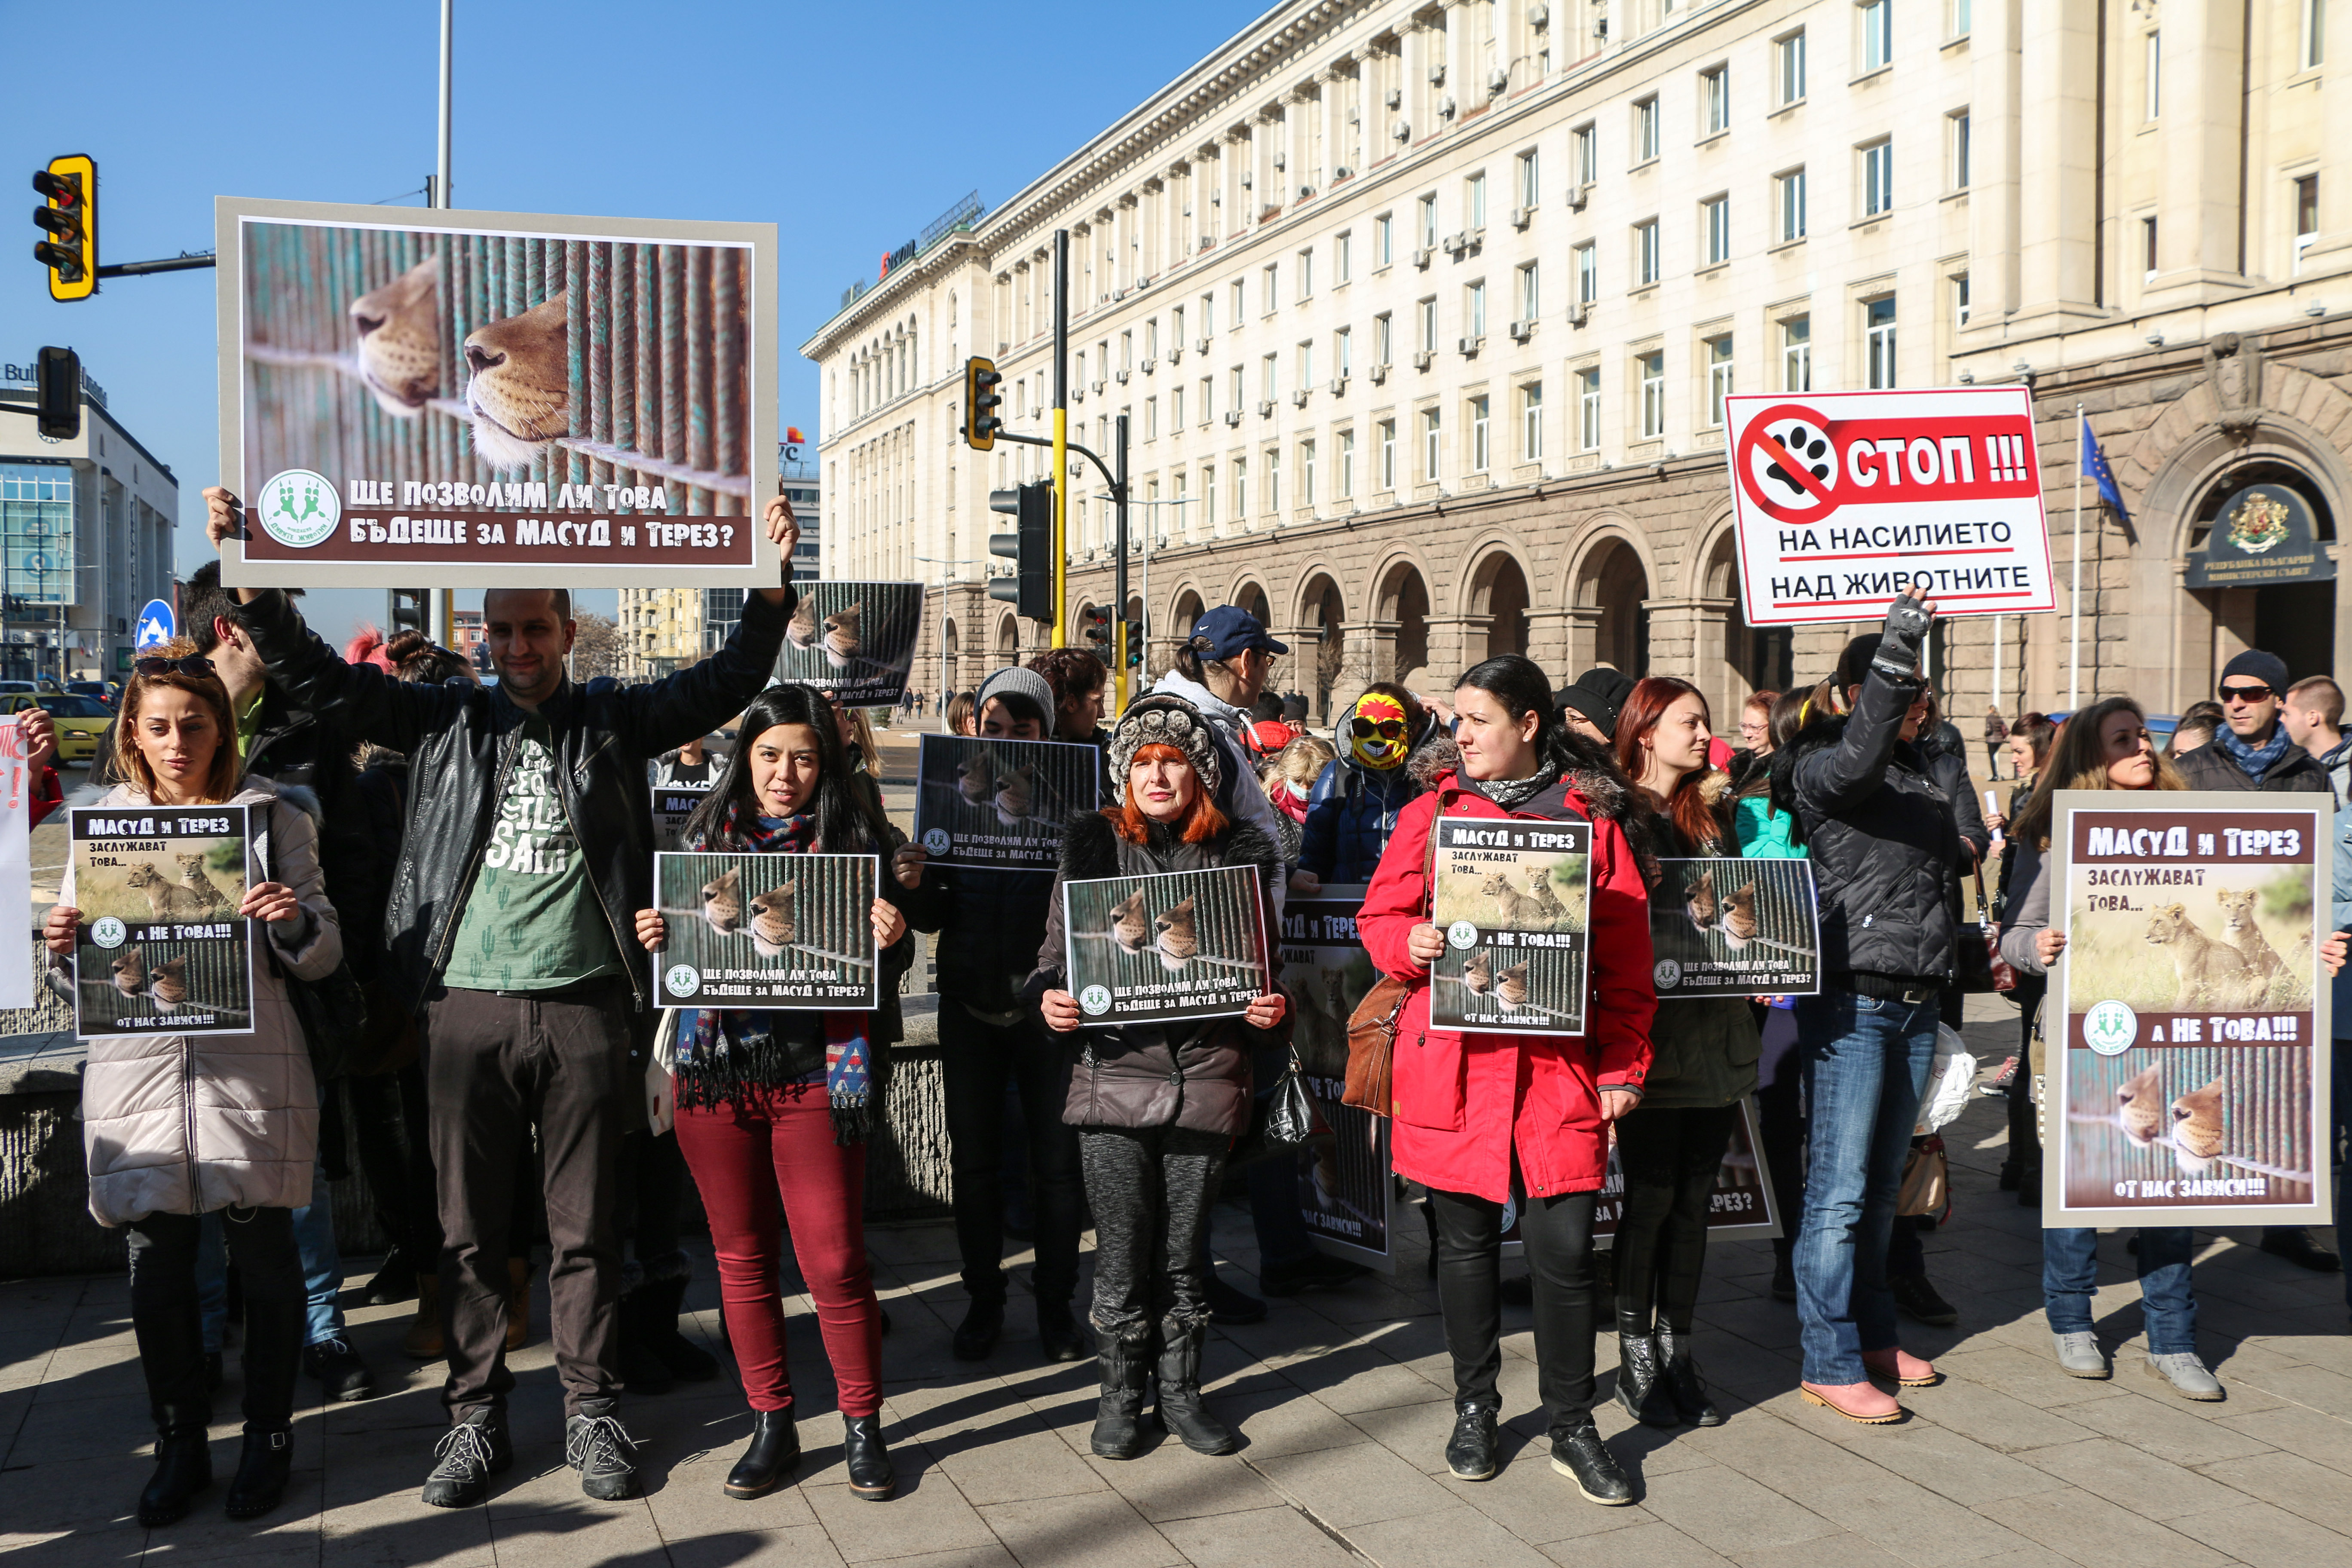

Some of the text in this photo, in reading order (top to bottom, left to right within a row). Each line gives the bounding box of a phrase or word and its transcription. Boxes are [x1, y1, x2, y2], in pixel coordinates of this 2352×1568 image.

[1846, 434, 2027, 487] СТОП !!!
[350, 480, 667, 510] ЩЕ ПОЗВОЛИМ ЛИ ТОВА
[350, 516, 467, 544] БЪДЕЩЕ
[477, 524, 505, 545] ЗА
[515, 519, 611, 546] МАСУД
[646, 522, 734, 548] ТЕРЕЗ?
[1779, 521, 2011, 551] НА НАСИЛИЕТО
[1771, 567, 2030, 600] НАД ЖИВОТНИТЕ
[666, 797, 699, 811] МАС
[89, 818, 155, 836] МАСУД
[178, 817, 230, 833] ТЕРЕЗ
[89, 841, 167, 852] ЗАСЛУЖАВАТ
[486, 820, 576, 874] SALT
[1452, 830, 1509, 847] МАСУД
[1529, 832, 1575, 848] ТЕРЕЗ
[2088, 826, 2189, 856] МАСУД
[2223, 828, 2300, 856] ТЕРЕЗ
[90, 856, 126, 867] ТОВА...
[1452, 851, 1518, 863] ЗАСЛУЖАВАТ
[1452, 865, 1482, 875] ТОВА...
[2088, 868, 2205, 886] ЗАСЛУЖАВАТ
[2088, 895, 2143, 912] ТОВА...
[150, 926, 169, 940] НЕ
[174, 923, 231, 940] ТОВА!!!
[1498, 933, 1514, 946] НЕ
[1519, 933, 1571, 948] ТОВА!!!
[703, 968, 836, 981] ЩЕ ПОЗВОЛИМ ЛИ ТОВА
[1684, 960, 1789, 972] ЩЕ ПОЗВОЛИМ ЛИ ТОВА
[1114, 977, 1237, 997] ЩЕ ПОЗВОЛИМ ЛИ ТОВА
[1683, 976, 1721, 986] БЪДЕЩЕ
[1737, 974, 1770, 984] МАСУД
[1781, 974, 1811, 984] ТЕРЕЗ?
[703, 984, 752, 996] БЪДЕЩЕ
[755, 986, 768, 995] ЗА
[772, 985, 812, 997] МАСУД
[827, 986, 865, 997] ТЕРЕЗ?
[1115, 999, 1161, 1012] БЪДЕЩЕ
[1164, 999, 1176, 1009] ЗА
[1179, 996, 1217, 1007] МАСУД
[1229, 989, 1262, 1002] ТЕРЕЗ?
[117, 1014, 214, 1027] ОТ НАС ЗАВИСИ!!!
[1464, 1014, 1550, 1026] ОТ НАС ЗАВИСИ!!!
[2172, 1017, 2202, 1042] НЕ
[2209, 1016, 2297, 1042] ТОВА!!!
[2115, 1178, 2265, 1197] ОТ НАС ЗАВИСИ!!!
[1709, 1193, 1752, 1213] РЕЗ?
